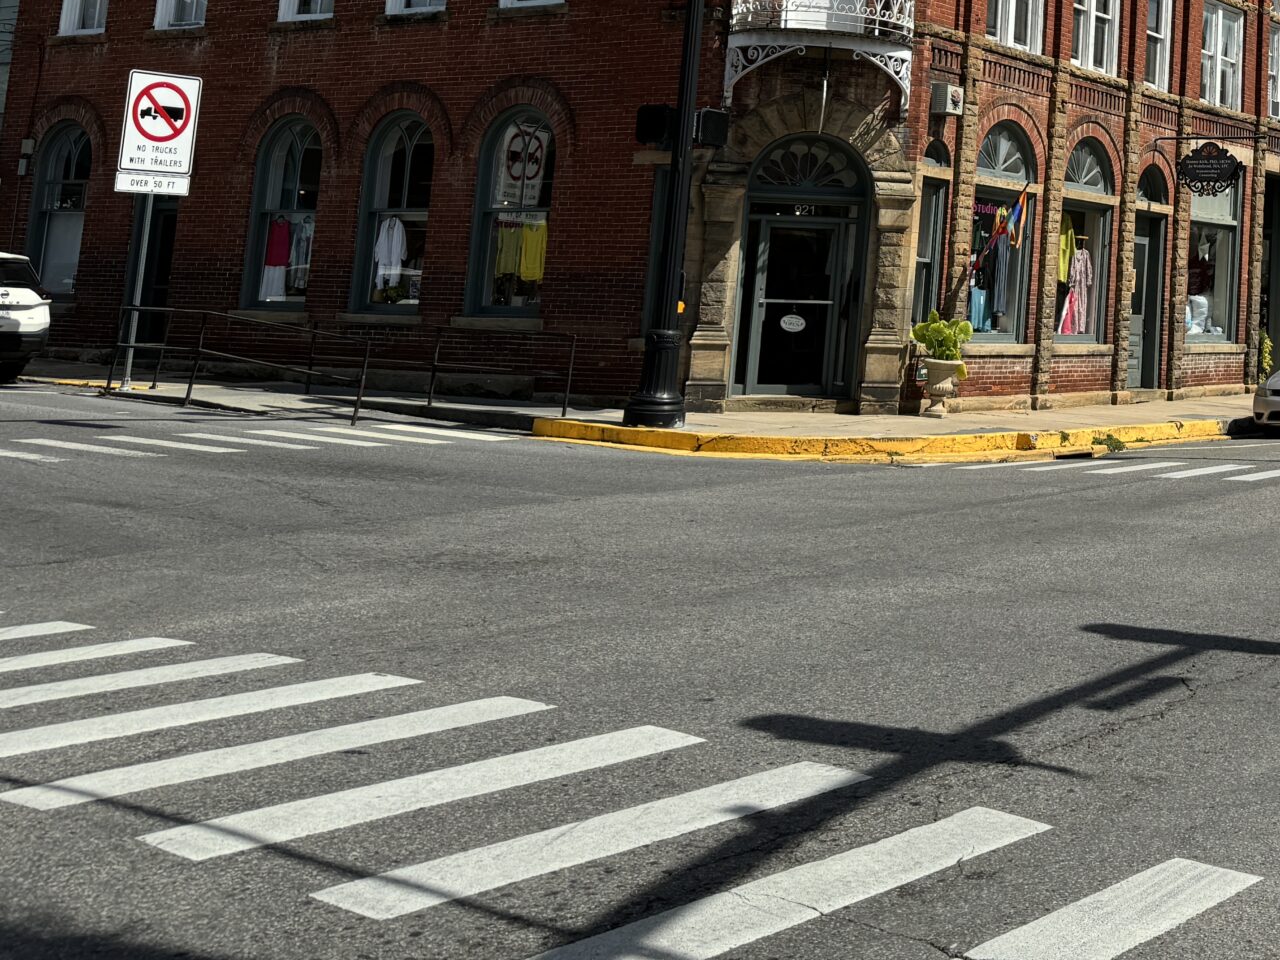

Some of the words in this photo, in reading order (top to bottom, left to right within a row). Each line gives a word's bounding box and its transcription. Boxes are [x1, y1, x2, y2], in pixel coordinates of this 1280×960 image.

[137, 144, 146, 152] NO
[151, 145, 178, 154] TRUCKS
[129, 156, 146, 165] WITH
[150, 158, 183, 168] TRAILERS
[130, 179, 149, 187] OVER
[153, 180, 163, 188] 50
[167, 181, 176, 189] FT
[795, 204, 815, 215] 921
